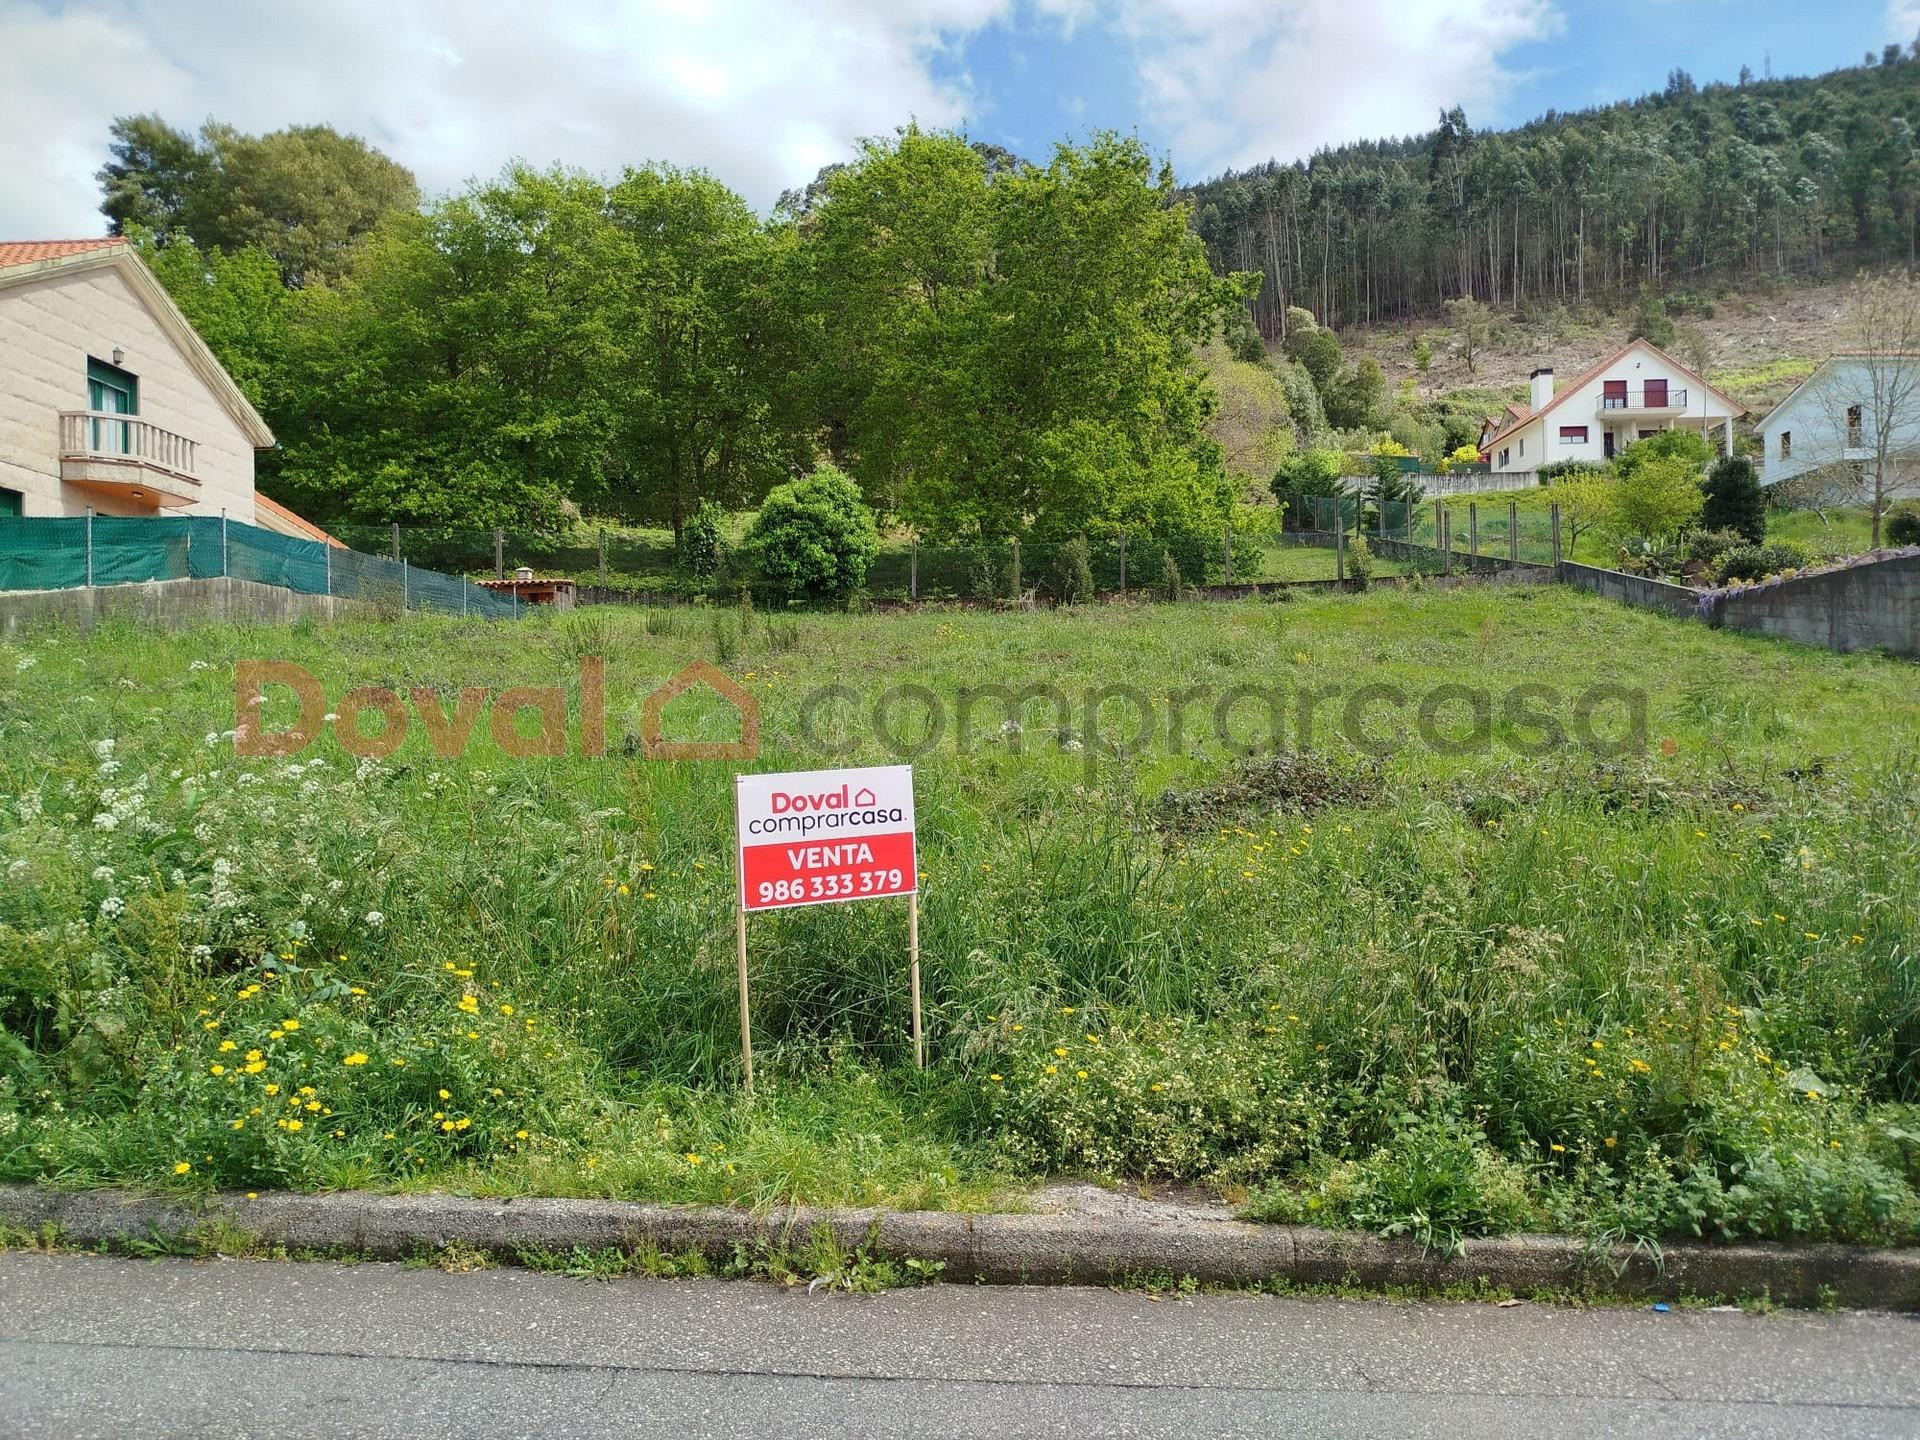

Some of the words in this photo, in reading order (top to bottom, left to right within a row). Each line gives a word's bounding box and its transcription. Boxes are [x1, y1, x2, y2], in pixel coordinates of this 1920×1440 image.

[772, 784, 848, 814] Doval
[787, 843, 874, 870] VENTA
[759, 878, 805, 903] 986
[810, 873, 854, 897] 333
[859, 869, 902, 892] 379
